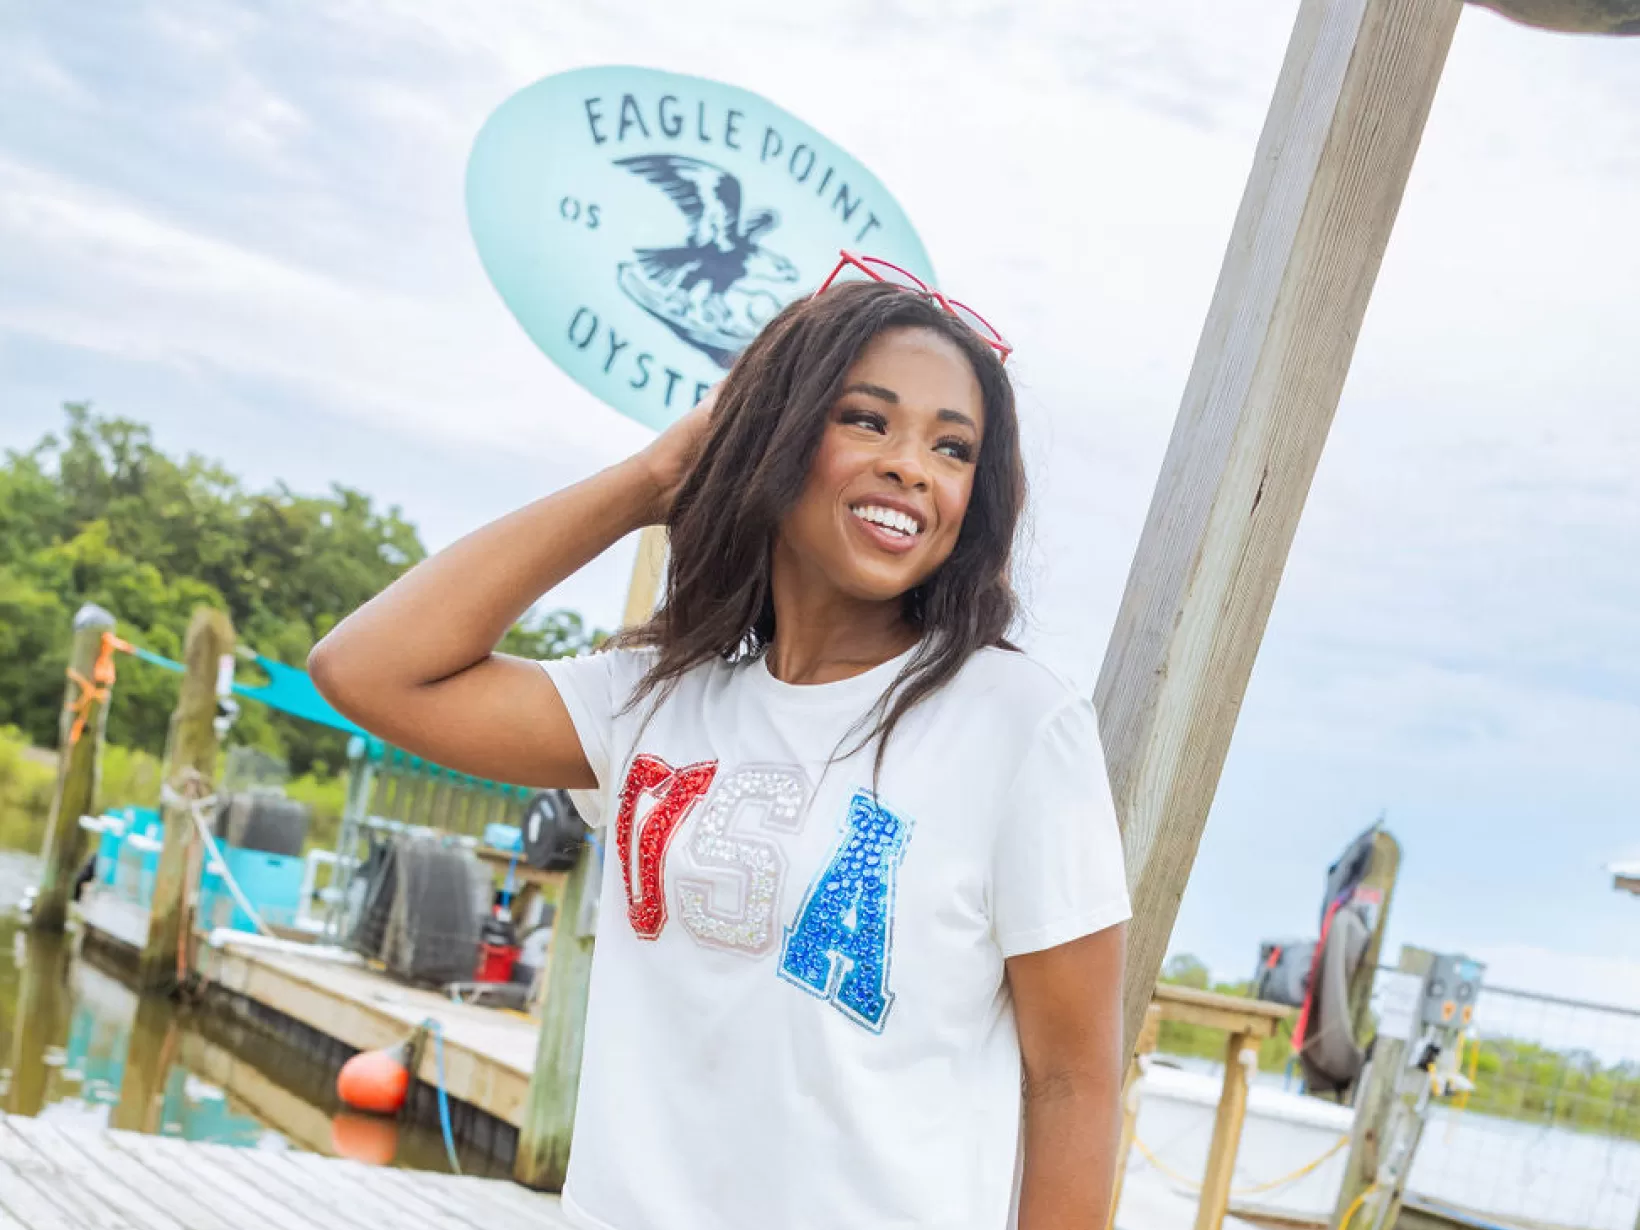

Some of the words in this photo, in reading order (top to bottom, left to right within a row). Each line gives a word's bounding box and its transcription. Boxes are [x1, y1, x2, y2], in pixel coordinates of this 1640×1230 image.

[558, 196, 601, 230] OS
[583, 94, 744, 149] EAGLE
[759, 127, 882, 243] POINT
[616, 754, 913, 1035] USA
